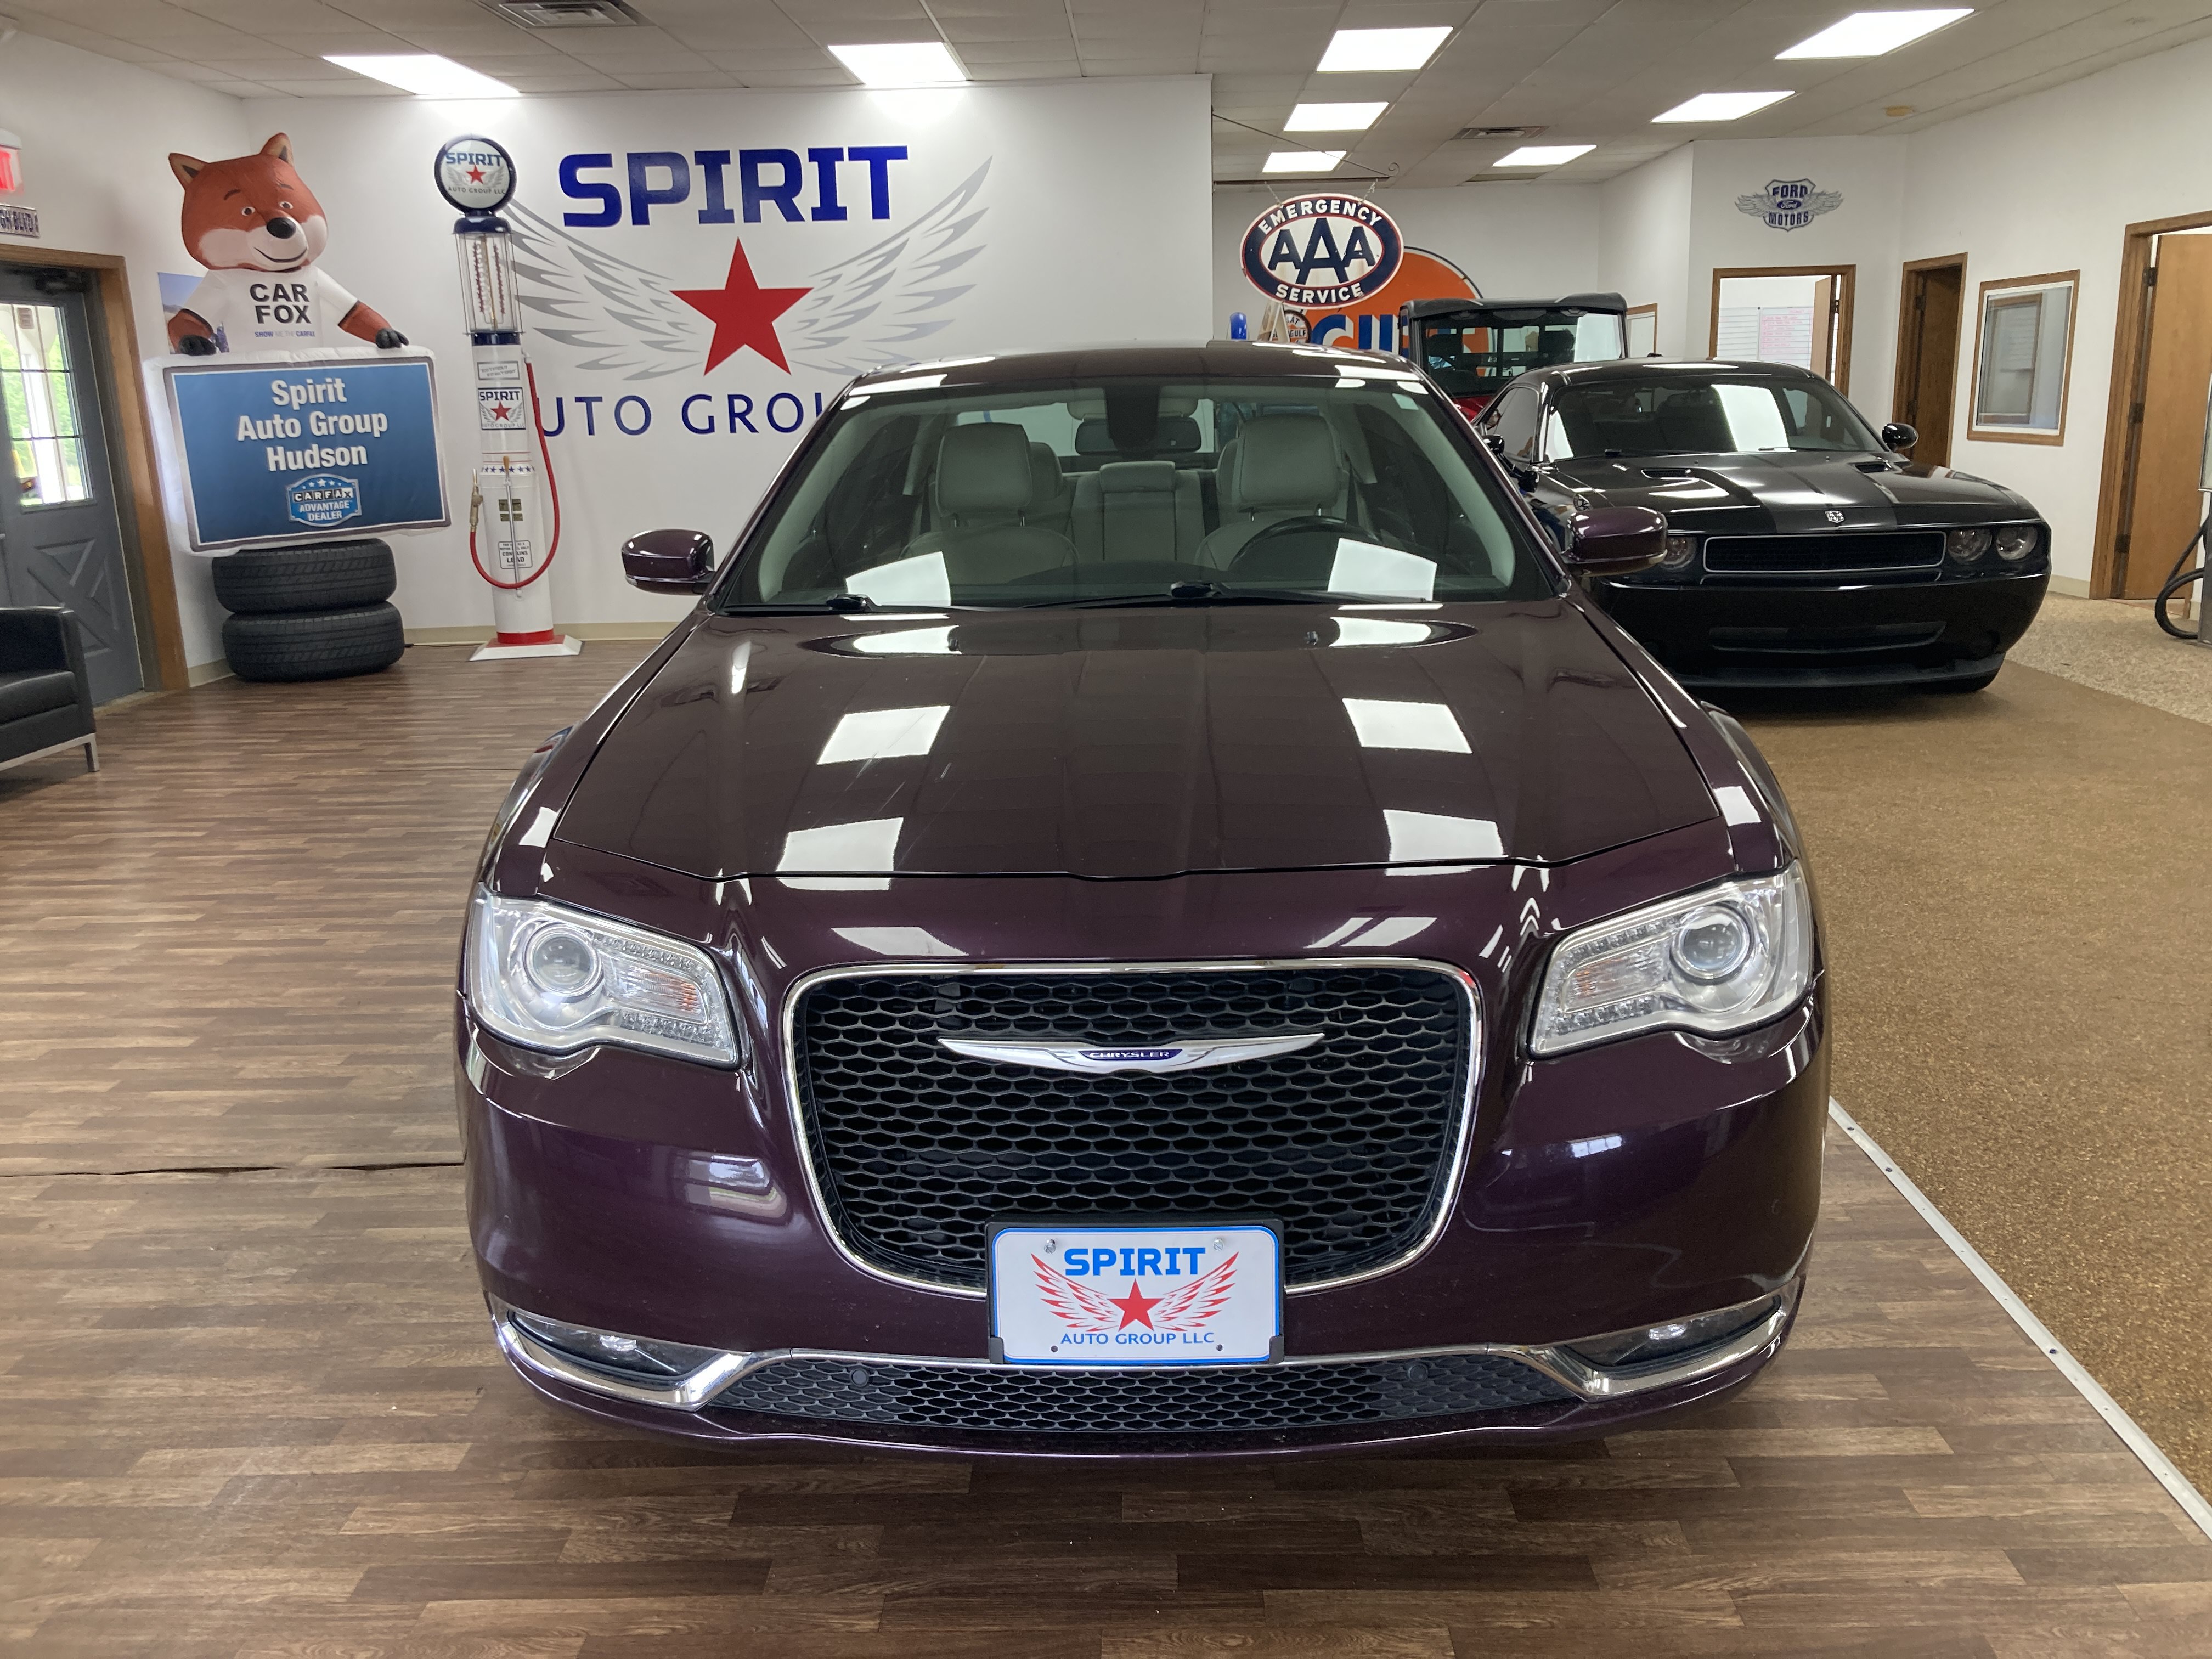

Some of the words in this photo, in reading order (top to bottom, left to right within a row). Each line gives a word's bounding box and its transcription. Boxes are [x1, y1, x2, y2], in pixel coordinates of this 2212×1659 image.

[446, 152, 502, 167] SPIRIT
[559, 145, 908, 228] SPIRIT
[1773, 184, 1808, 199] FORD
[1780, 200, 1798, 209] Ford
[1258, 199, 1382, 235] EMERGENCY
[1769, 211, 1809, 226] MOTORS
[1268, 217, 1375, 285] AAA
[250, 283, 311, 302] CAR
[1276, 282, 1364, 304] SERVICE
[255, 304, 312, 324] FOX
[271, 377, 347, 410] Spirit
[479, 391, 520, 401] SPIRIT
[538, 394, 652, 437] UTO
[237, 415, 302, 441] Auto
[310, 411, 389, 437] Group
[267, 444, 368, 472] Hudson
[294, 489, 353, 502] CARFAX
[299, 500, 350, 512] ADVANTAGE
[307, 511, 342, 521] DEALER
[1063, 1247, 1206, 1276] SPIRIT
[1060, 1333, 1108, 1345] AUTO
[1115, 1333, 1176, 1345] GROUP
[1183, 1331, 1215, 1344] LLC
